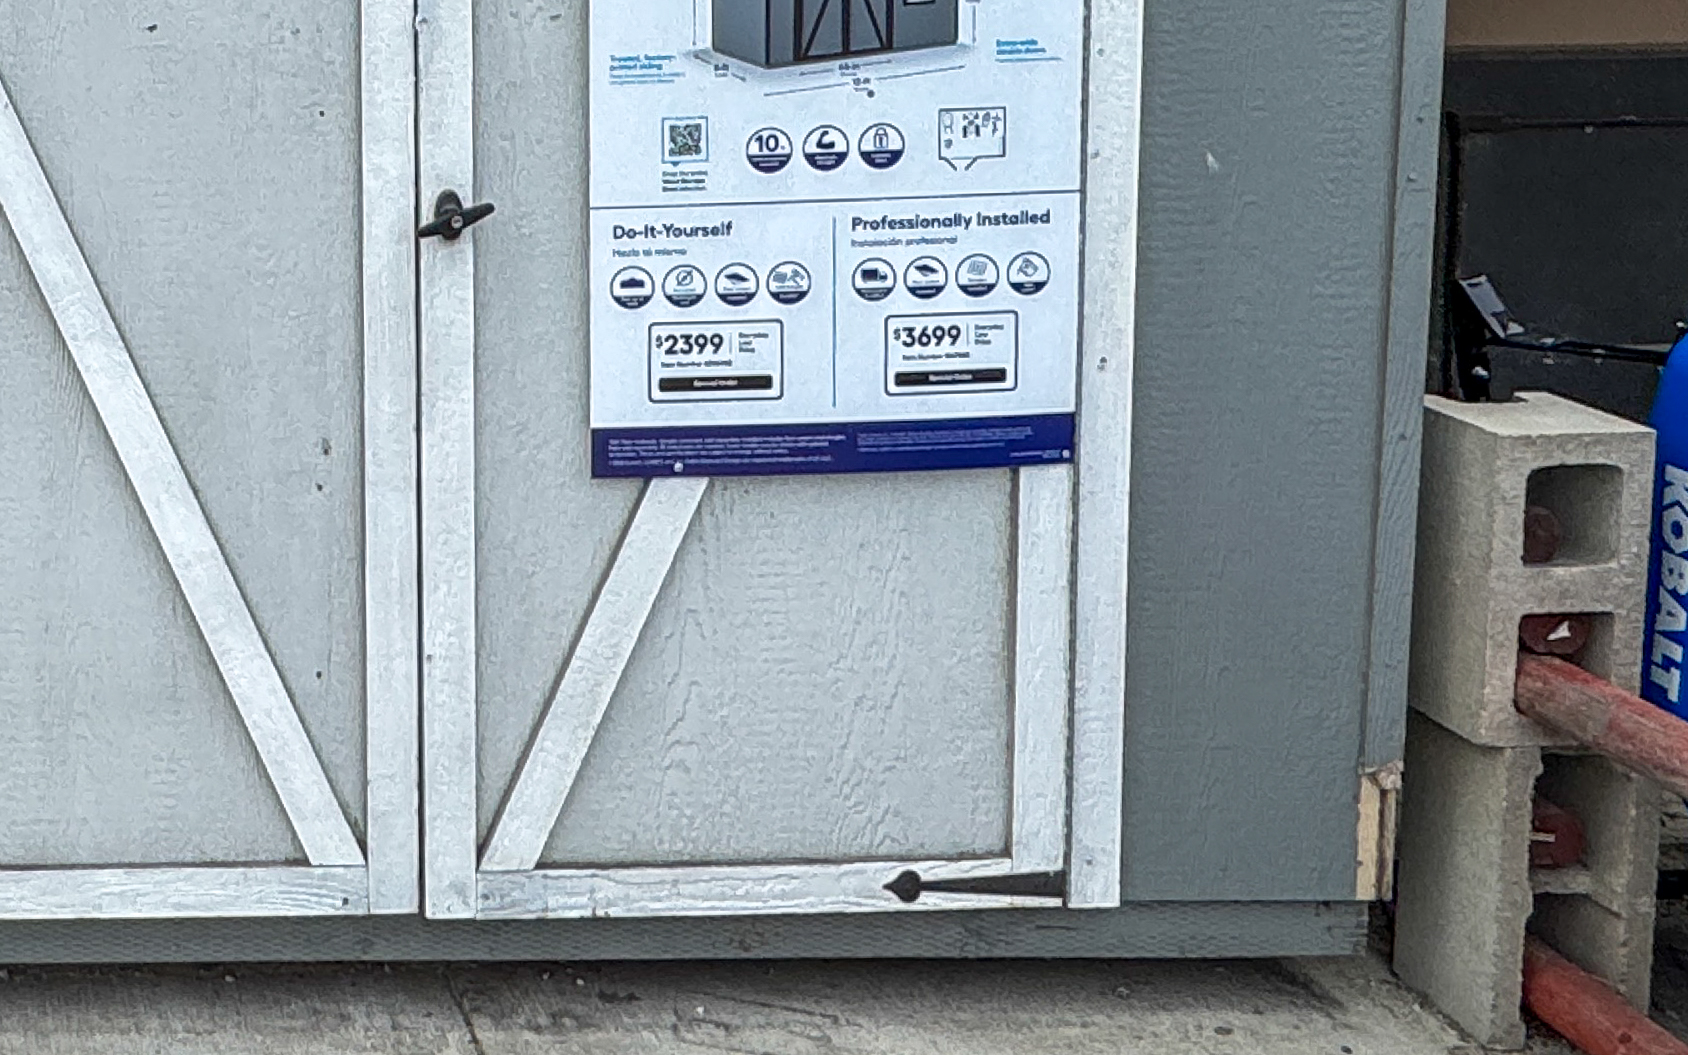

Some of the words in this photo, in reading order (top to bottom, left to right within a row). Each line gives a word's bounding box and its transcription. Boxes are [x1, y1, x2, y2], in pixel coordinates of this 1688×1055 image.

[753, 134, 780, 152] 10
[612, 220, 733, 240] Do-It-Yourself
[851, 213, 973, 231] Professionally
[976, 208, 1051, 227] Installed
[893, 324, 961, 348] $3699
[1649, 462, 1688, 704] KOBALT
